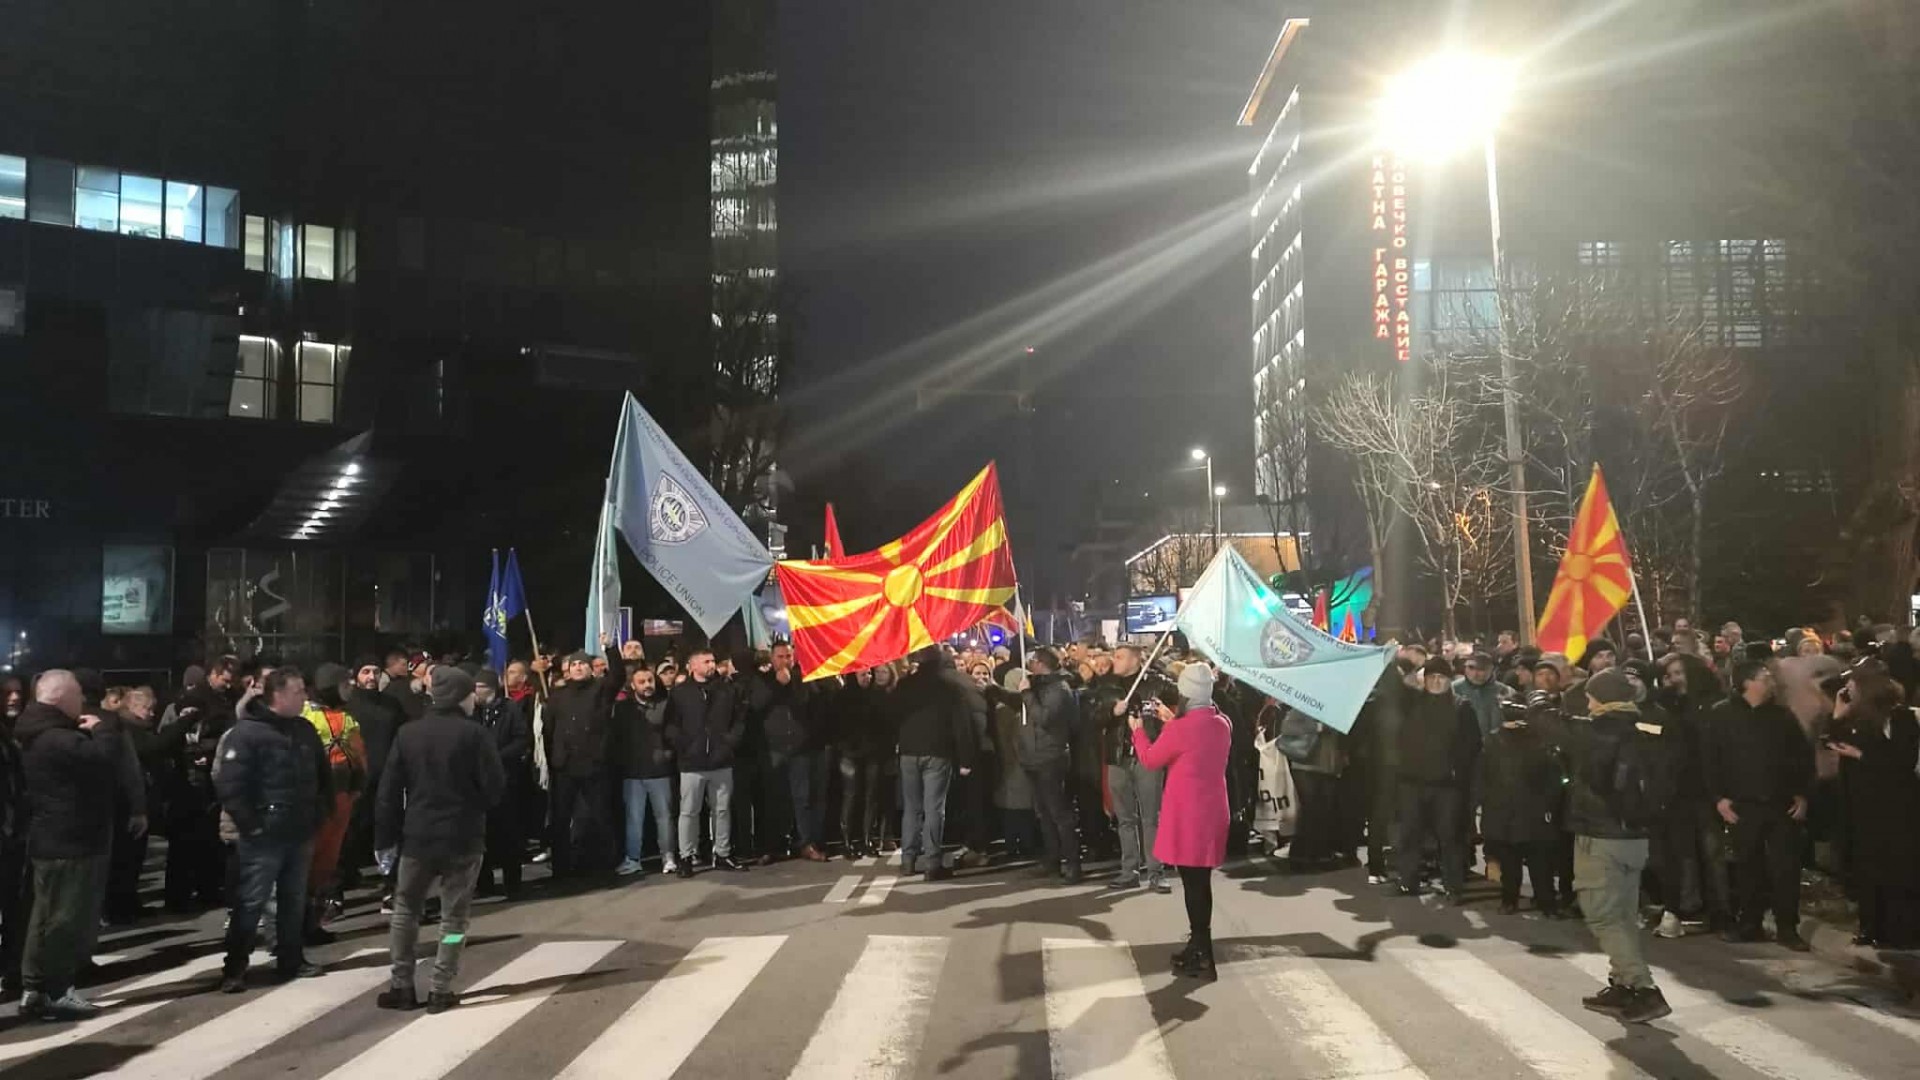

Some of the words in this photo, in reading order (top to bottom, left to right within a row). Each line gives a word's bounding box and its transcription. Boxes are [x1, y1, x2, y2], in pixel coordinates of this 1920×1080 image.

[1372, 155, 1386, 230] КАТНА
[1375, 247, 1390, 338] ГАРАЖА
[639, 549, 677, 585] POLICE
[675, 583, 705, 618] UNION
[1259, 673, 1294, 696] POLICE
[1294, 690, 1325, 712] UNION
